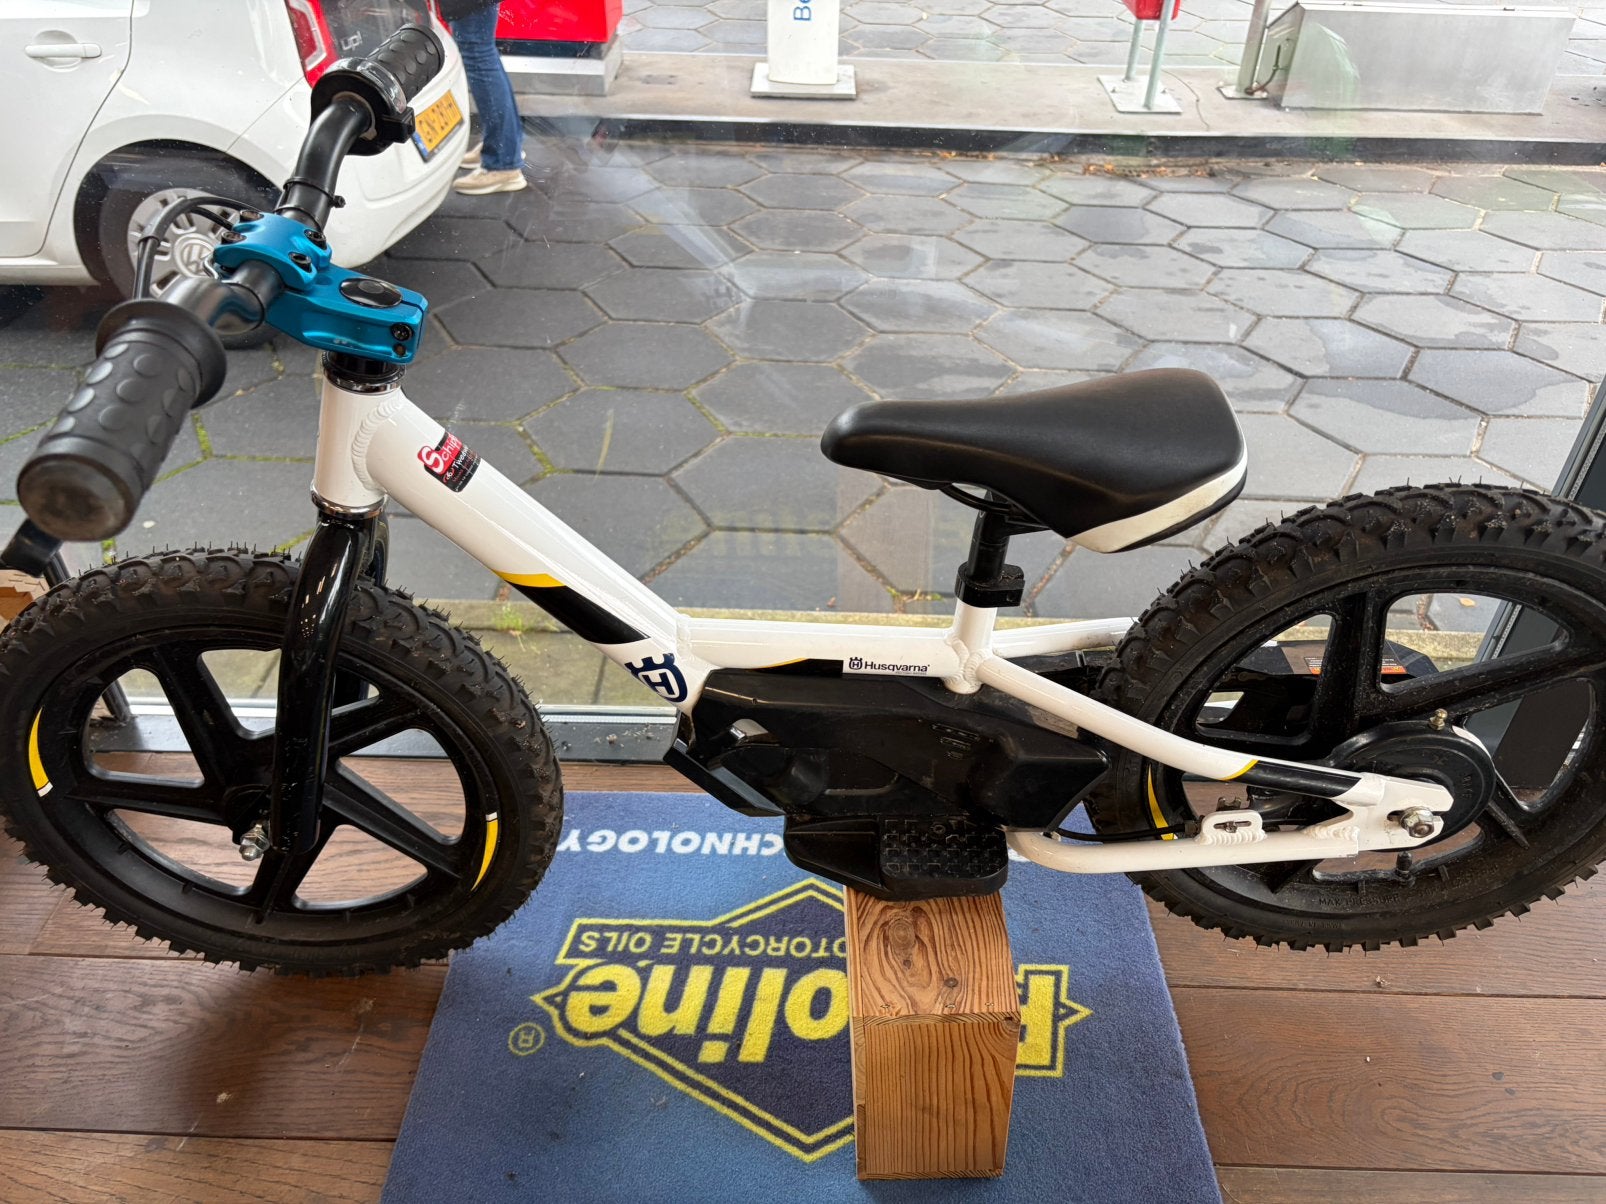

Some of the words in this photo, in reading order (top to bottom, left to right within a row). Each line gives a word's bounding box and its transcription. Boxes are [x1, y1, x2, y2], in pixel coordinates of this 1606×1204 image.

[793, 0, 812, 21] B
[864, 661, 928, 672] Husqvarna
[556, 829, 786, 855] CHNOLOGY
[579, 931, 652, 953] OILS
[661, 933, 846, 957] OTORCYCLE
